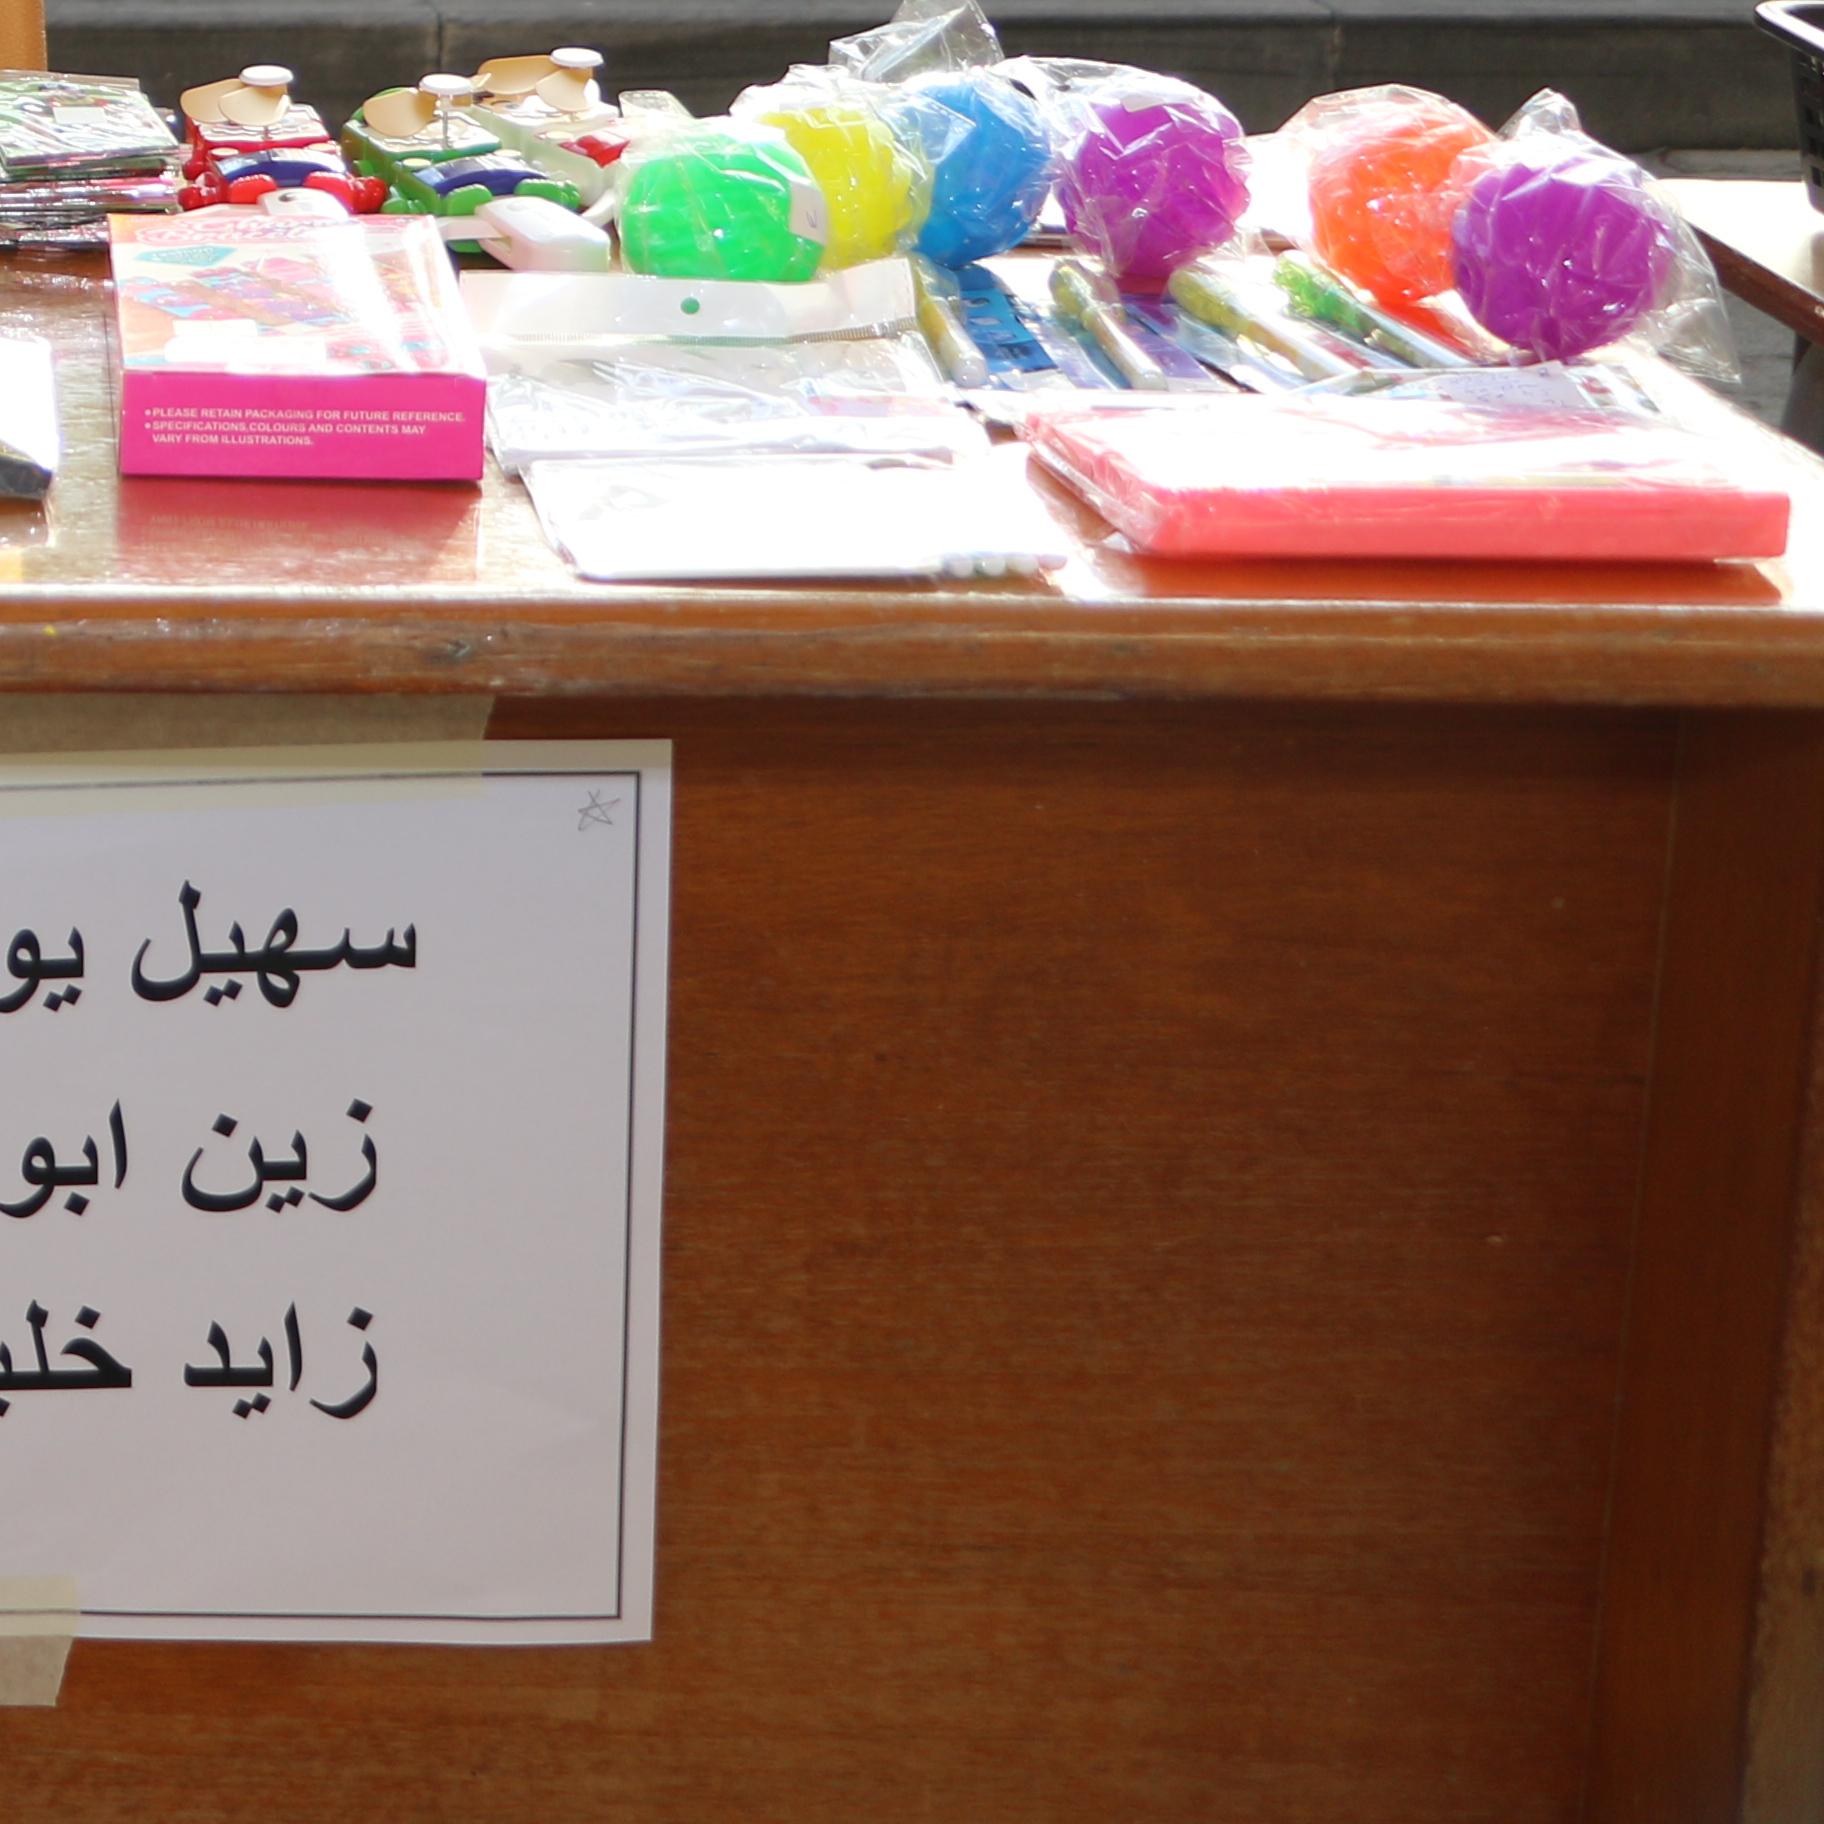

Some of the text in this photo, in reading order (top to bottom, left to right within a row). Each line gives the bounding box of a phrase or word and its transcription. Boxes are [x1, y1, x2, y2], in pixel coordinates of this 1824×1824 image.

[153, 407, 466, 422] PLEASE RETAIN PACKAGING FOR FUTURE REFERENCE.
[153, 433, 313, 446] VARY FROM ILLUSTRATIONS.
[308, 423, 332, 433] AND
[336, 423, 398, 434] CONTENTS
[401, 425, 426, 435] MAY
[132, 880, 416, 1009] سهيل
[181, 1099, 377, 1214] زين
[183, 1302, 378, 1420] زايد
